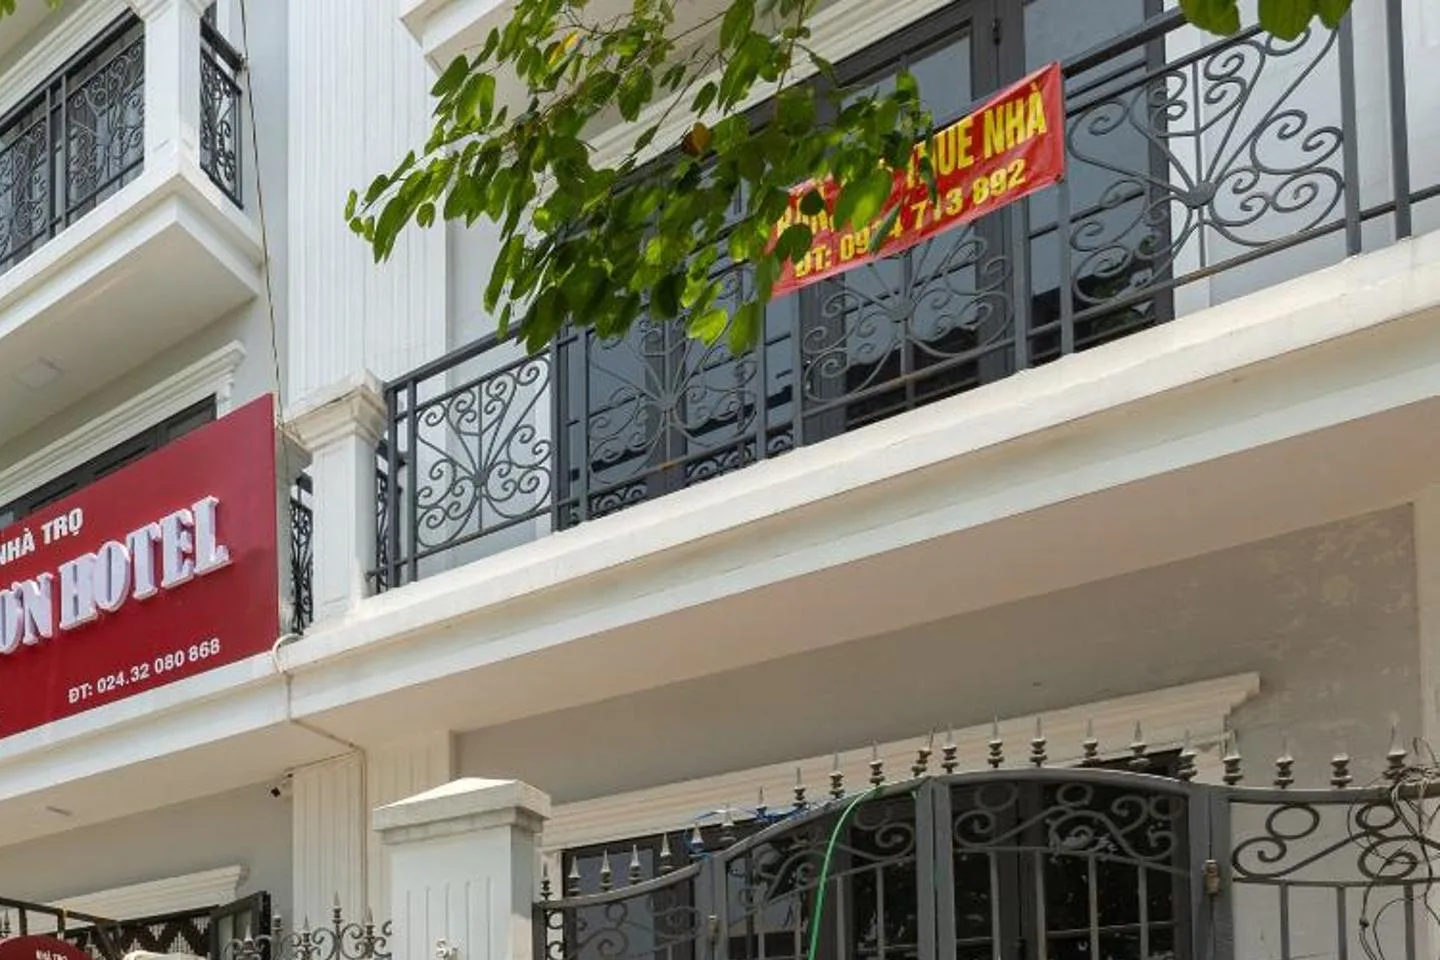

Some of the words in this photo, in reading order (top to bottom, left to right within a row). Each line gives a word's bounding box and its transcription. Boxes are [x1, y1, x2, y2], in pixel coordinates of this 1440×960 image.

[972, 158, 1027, 206] 892
[41, 507, 84, 545] TRỌ
[59, 495, 233, 631] HOTEL
[68, 683, 93, 704] ĐT:
[96, 663, 150, 694] 024.32
[154, 650, 185, 675] 080
[188, 637, 221, 662] 868
